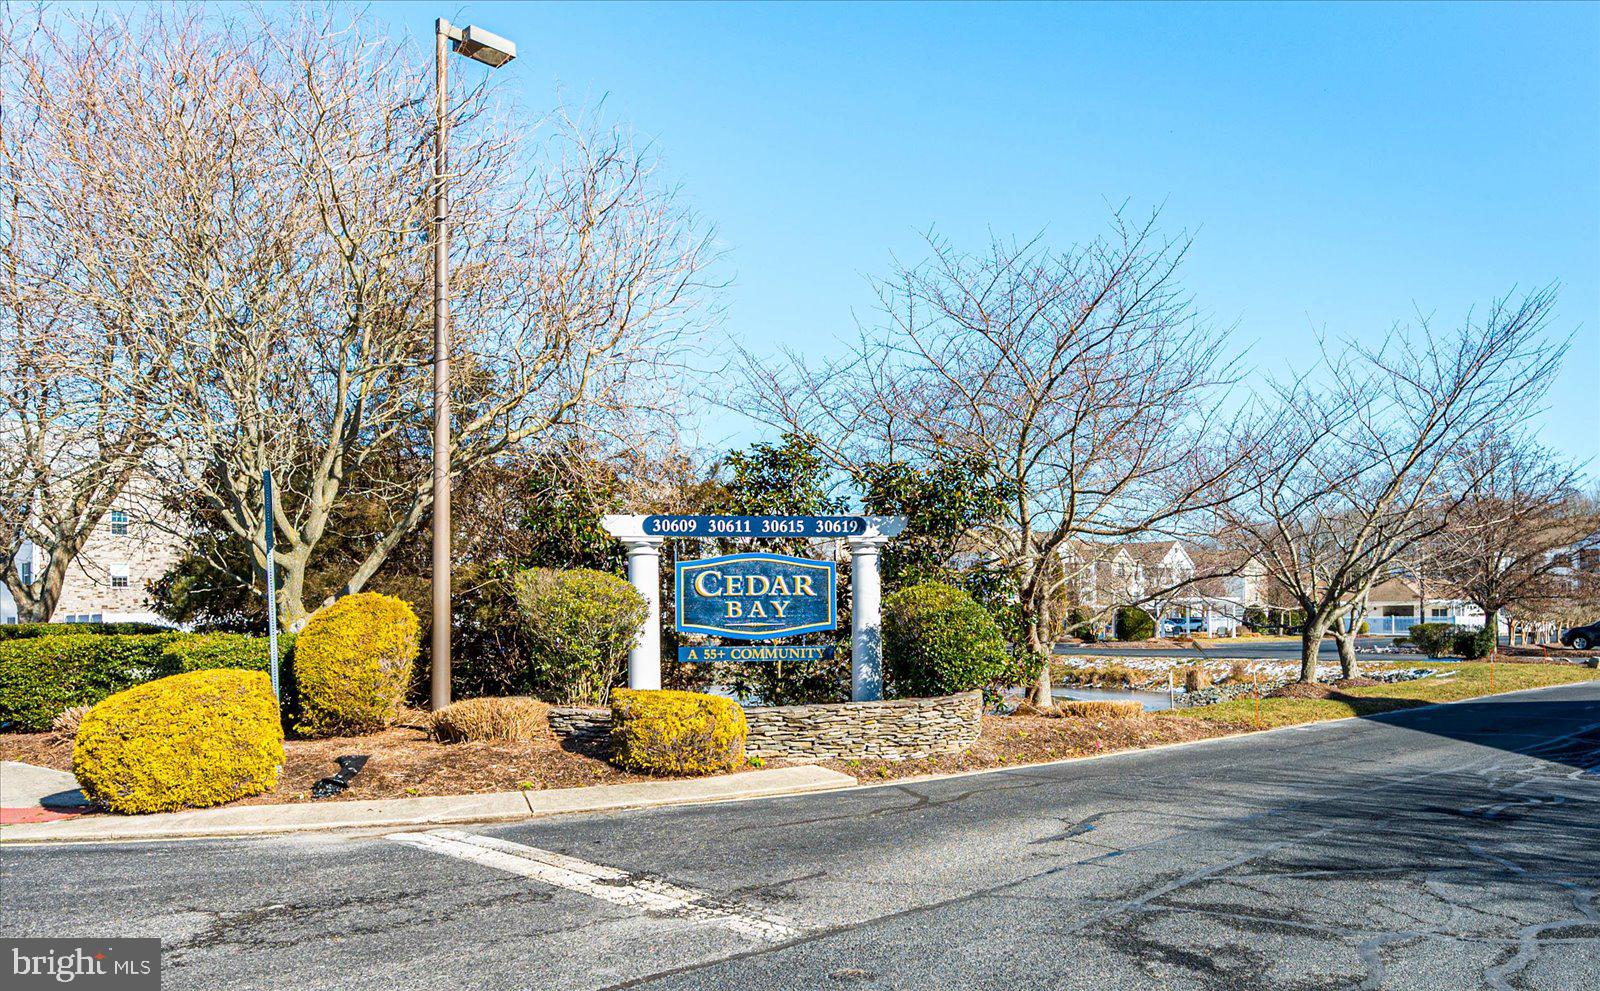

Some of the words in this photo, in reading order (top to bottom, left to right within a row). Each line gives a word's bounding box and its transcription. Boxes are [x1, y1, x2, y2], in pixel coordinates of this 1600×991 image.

[652, 519, 697, 533] 30609
[708, 519, 751, 533] 30611
[762, 519, 804, 533] 30615
[816, 519, 858, 533] 30619
[694, 570, 818, 598] CEDAR
[725, 600, 790, 618] BAY
[687, 649, 698, 660] A
[703, 649, 726, 660] 55+
[730, 646, 825, 660] COMMUNITY
